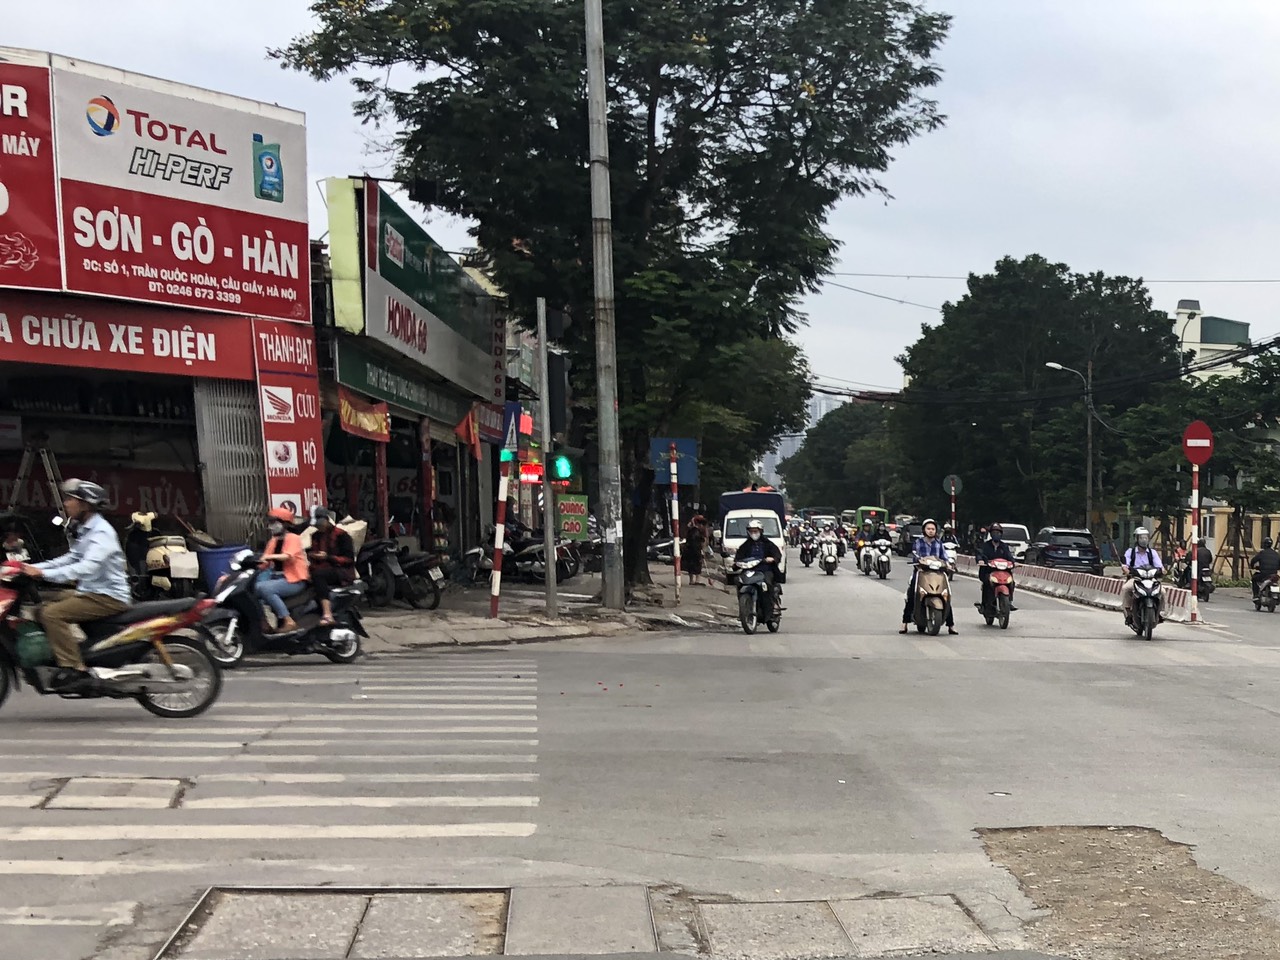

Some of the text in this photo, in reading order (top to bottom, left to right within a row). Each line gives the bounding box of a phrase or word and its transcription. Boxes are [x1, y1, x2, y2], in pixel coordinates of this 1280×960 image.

[0, 83, 28, 118] R
[2, 131, 41, 157] MÁY
[126, 108, 228, 155] TOTAL
[129, 147, 233, 190] HI-PERF
[73, 206, 143, 253] SƠN
[170, 217, 215, 265] GÒ
[241, 230, 299, 279] HÀN
[83, 258, 297, 302] ĐC: SỐ 1, TRẦN QUỐC HOÀN, CẦU GIẤY, HÀ NỘI
[148, 281, 241, 304] ĐT: 0246 673 3399
[22, 313, 101, 352] CHỮA
[108, 323, 145, 355] XE
[152, 325, 216, 366] ĐIỆN
[386, 297, 428, 355] HONDA 68
[259, 326, 313, 373] THÀNH ĐẠT
[266, 414, 293, 422] HONDA
[296, 389, 316, 419] CỨU
[302, 437, 317, 471] HỘ
[268, 467, 299, 478] YAMAHA
[558, 497, 586, 516] QUẢNG
[562, 517, 583, 533] CÁO
